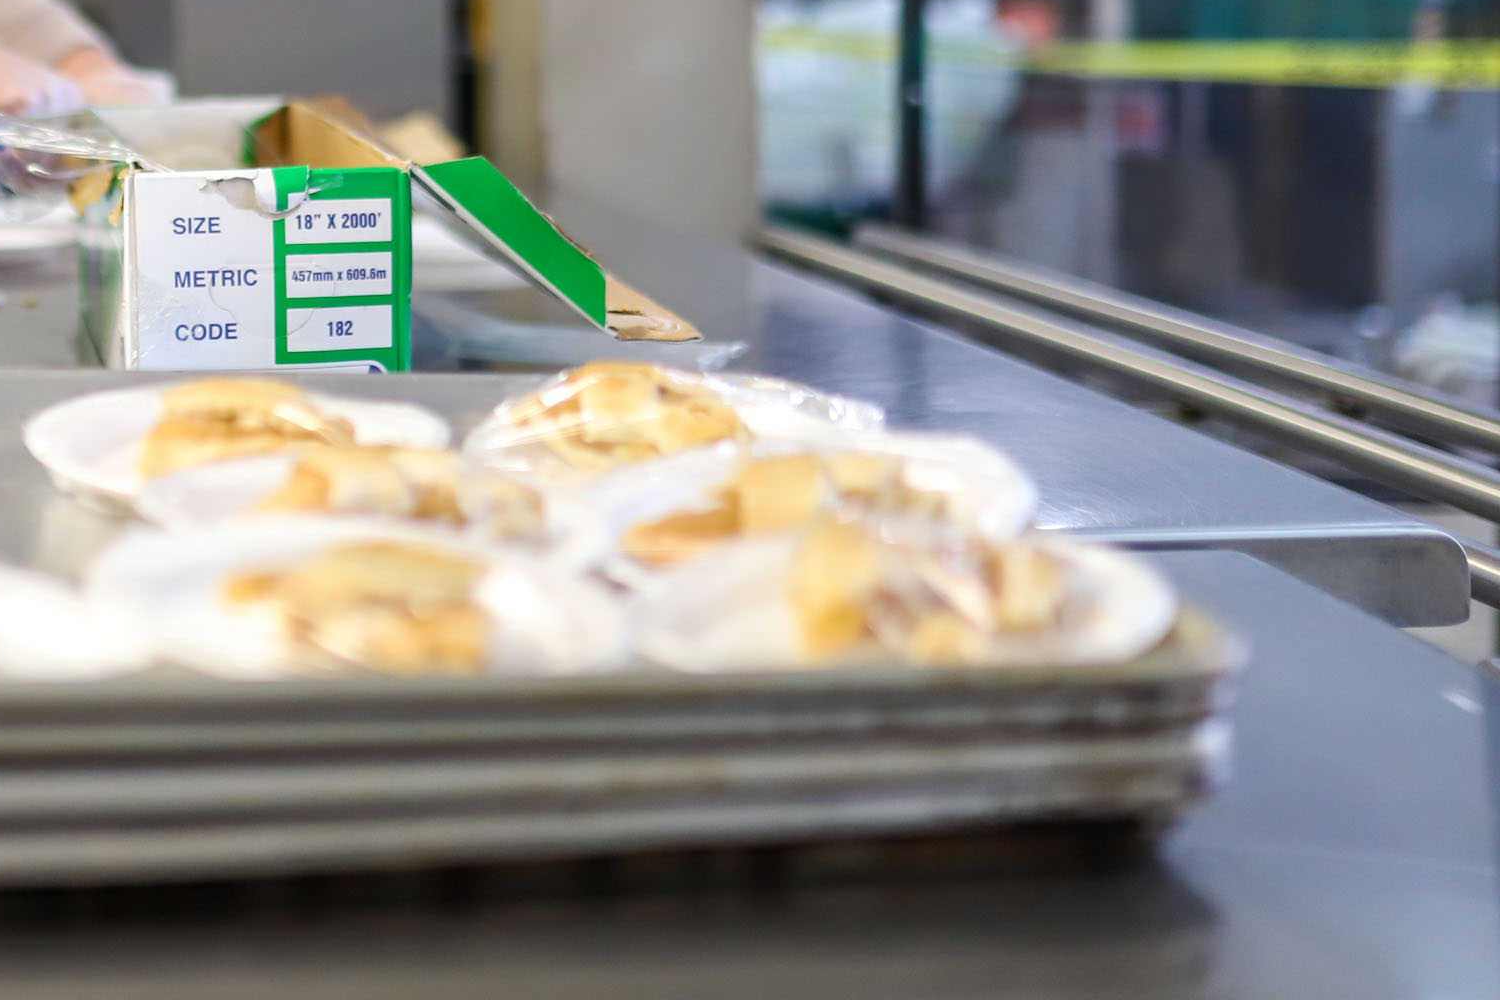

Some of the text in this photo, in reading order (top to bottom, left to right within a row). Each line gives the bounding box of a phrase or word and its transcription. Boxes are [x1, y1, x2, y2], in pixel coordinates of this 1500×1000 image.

[172, 212, 382, 235] SIZE 18" X 2000'
[174, 268, 387, 288] METRIC 457mm x 609.6m
[175, 320, 353, 342] CODE 182
